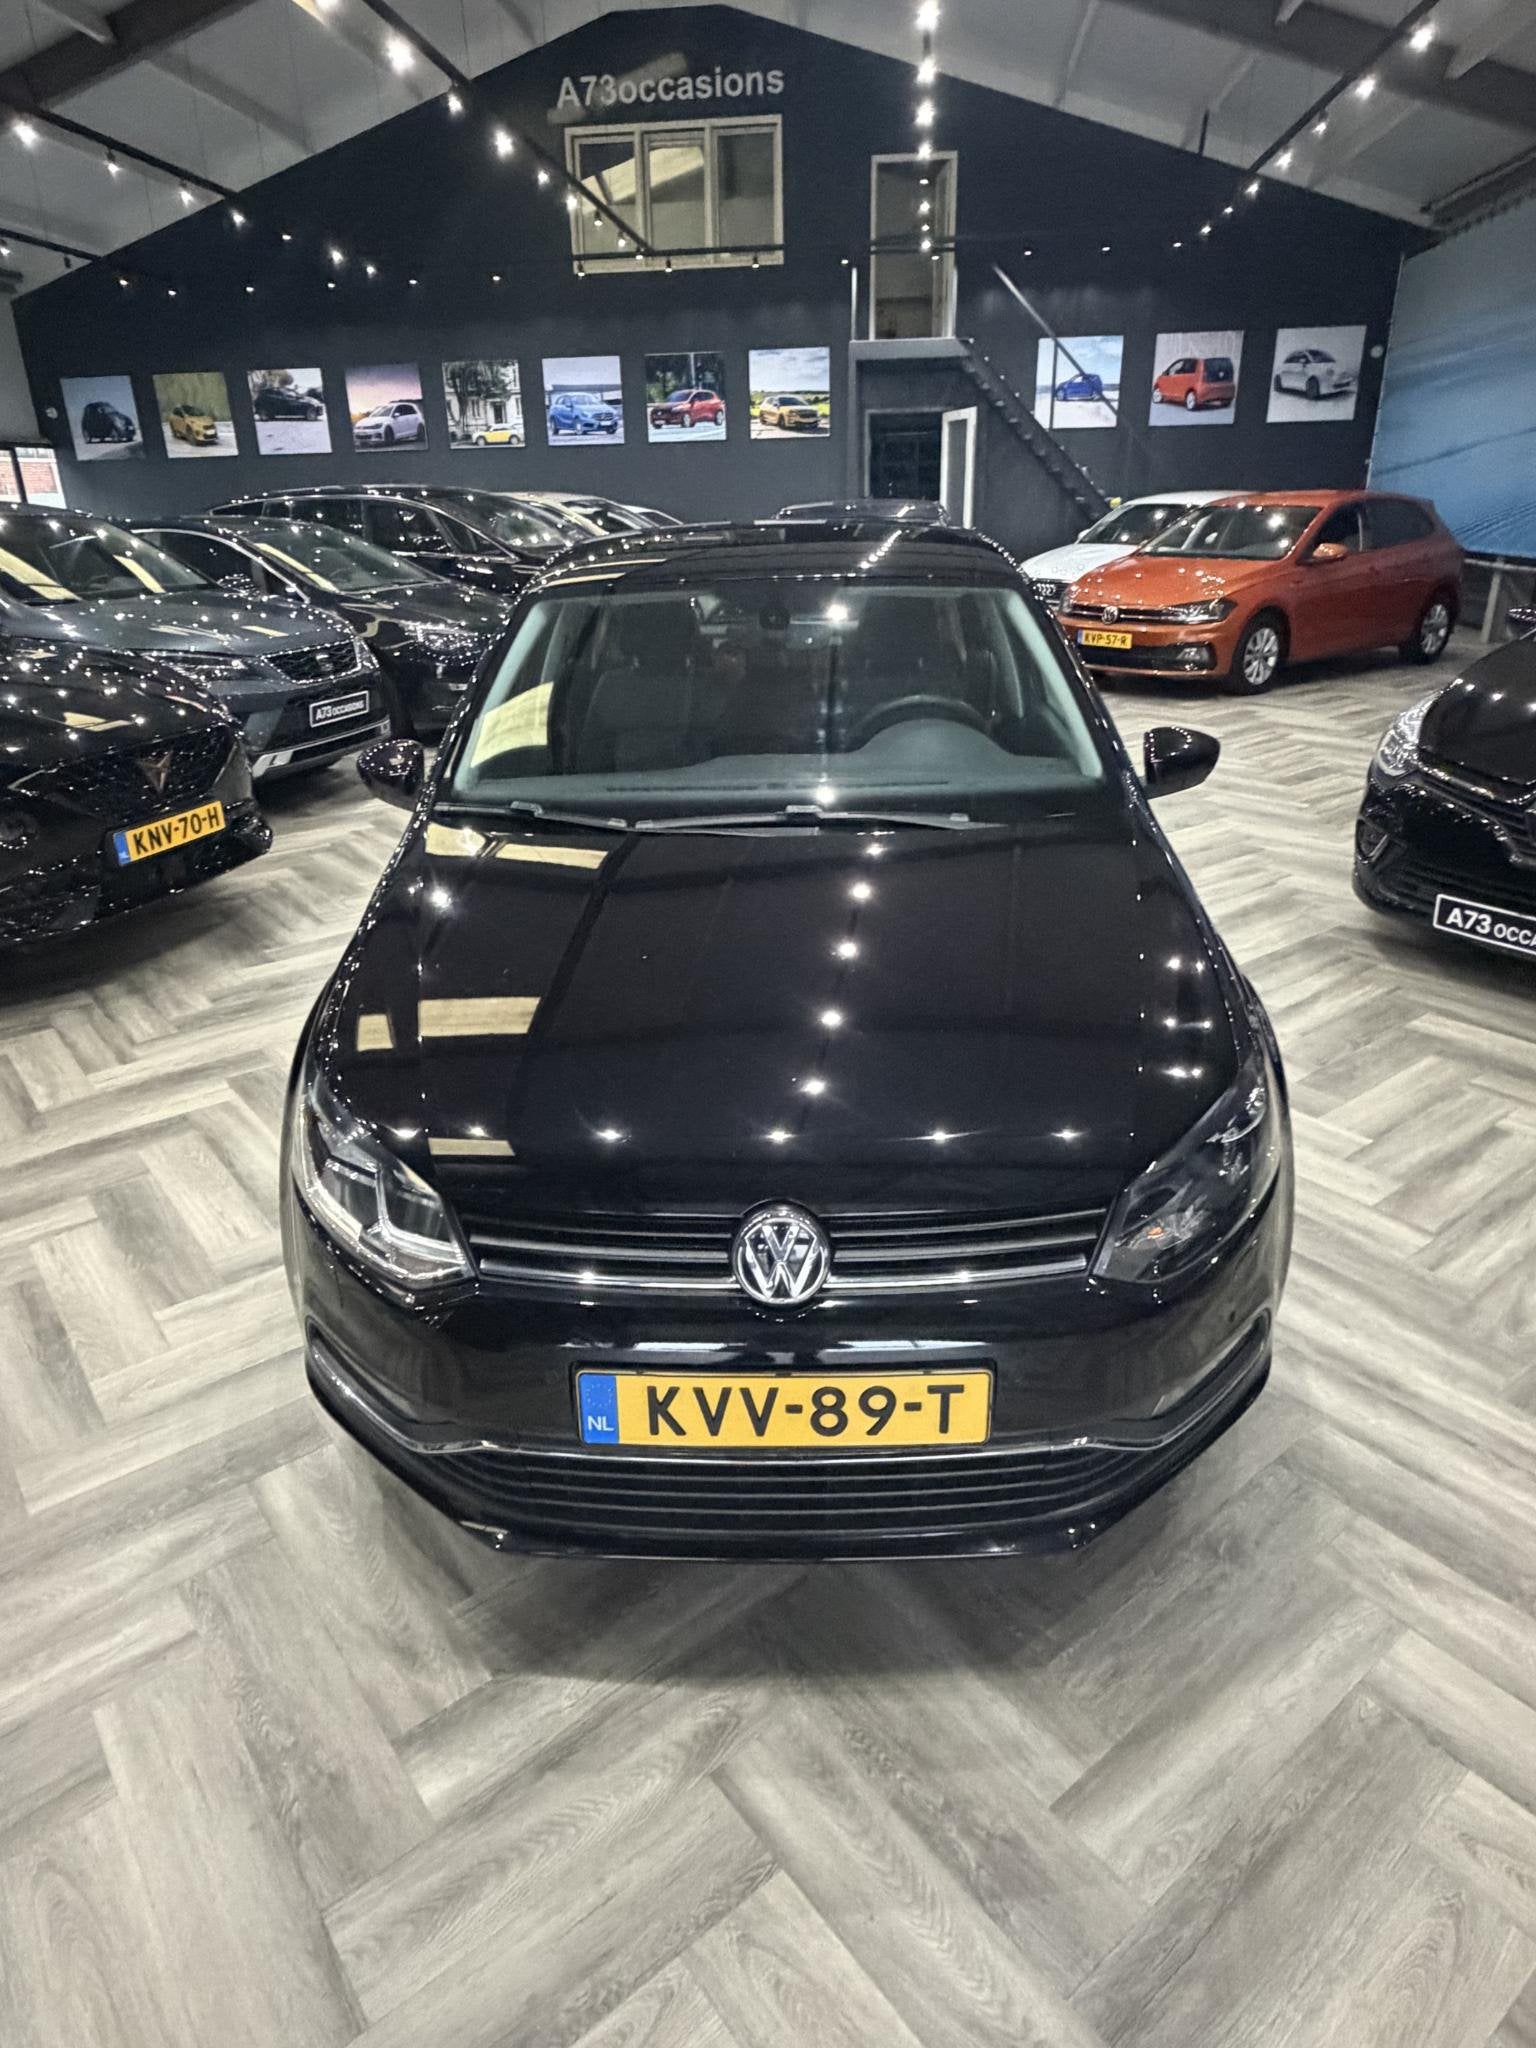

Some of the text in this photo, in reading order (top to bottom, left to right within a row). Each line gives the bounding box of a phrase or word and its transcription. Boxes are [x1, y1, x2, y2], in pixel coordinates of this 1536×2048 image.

[556, 65, 786, 110] A73occasions
[1084, 632, 1128, 647] KVP-57-R
[315, 705, 332, 721] A73
[132, 806, 220, 856] KNV-70-H
[1446, 907, 1492, 934] A73
[586, 1415, 615, 1432] NL
[646, 1384, 965, 1437] KVV-89-T
